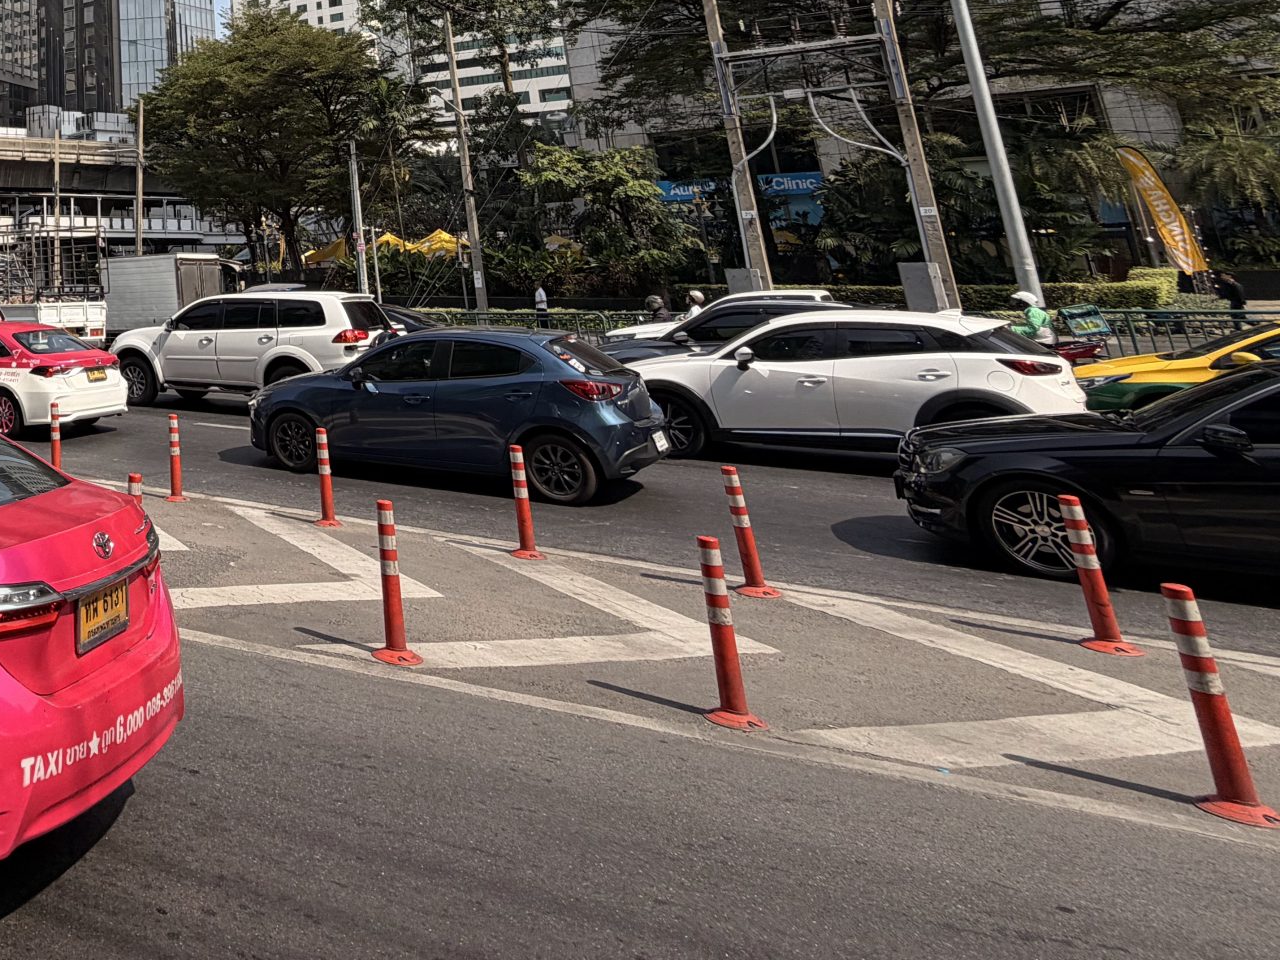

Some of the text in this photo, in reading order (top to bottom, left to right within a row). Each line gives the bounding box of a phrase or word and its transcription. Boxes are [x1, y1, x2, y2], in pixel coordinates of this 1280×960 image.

[772, 178, 816, 191] Clinic
[103, 582, 124, 613] 6131
[21, 748, 63, 788] TAXI
[116, 706, 145, 745] 6,000
